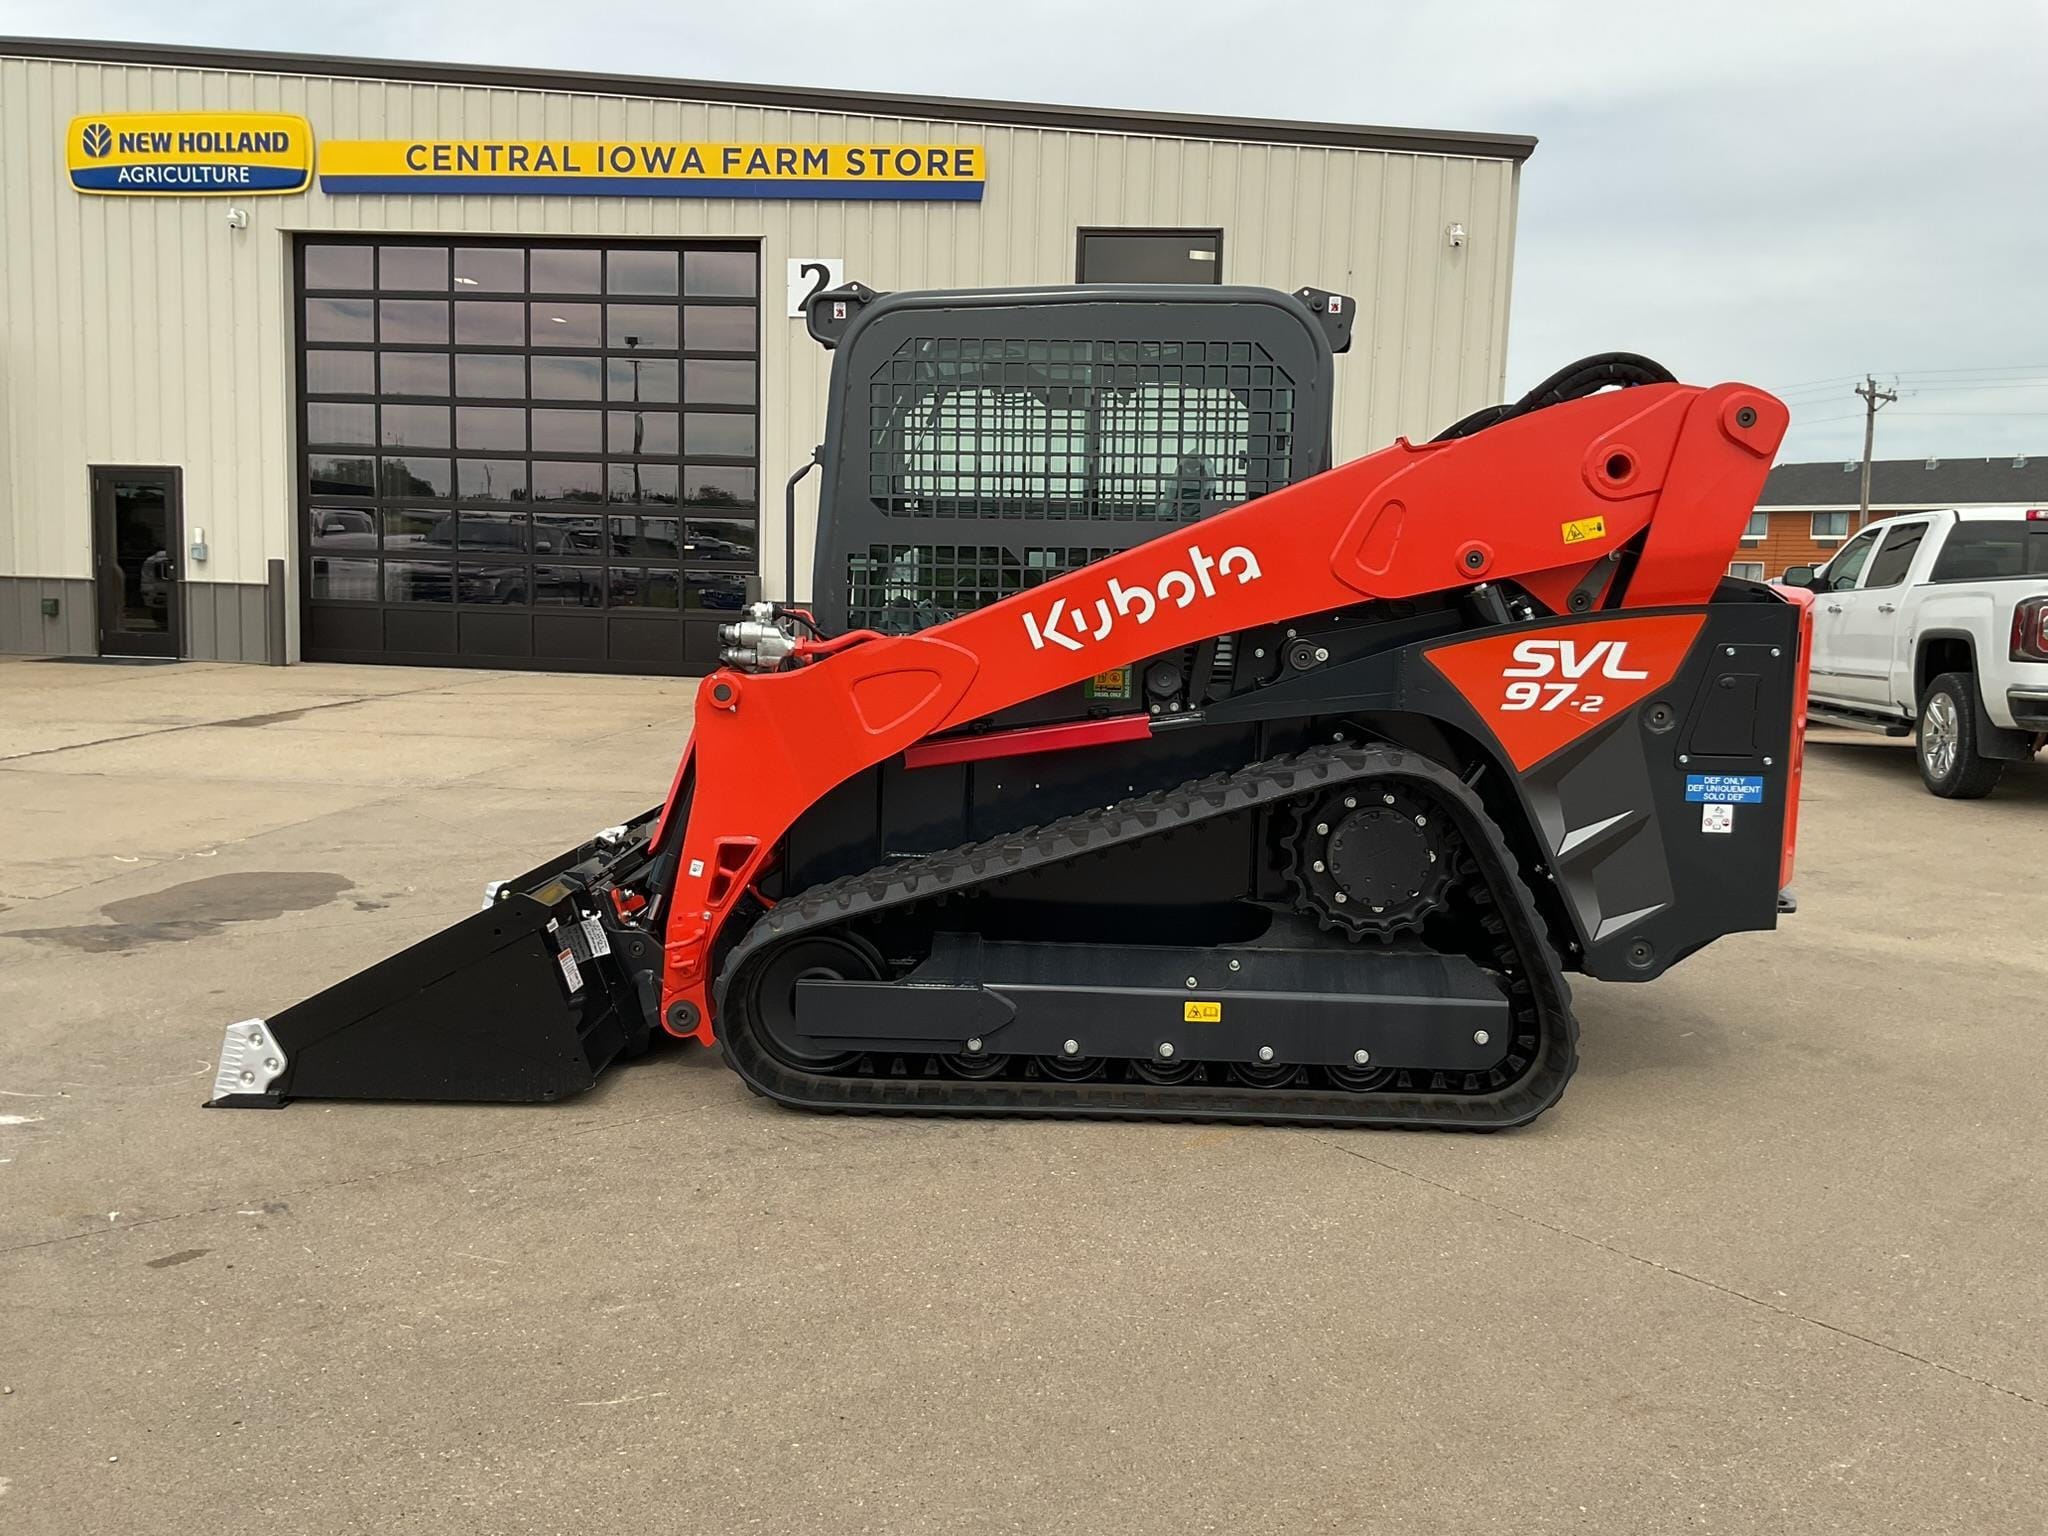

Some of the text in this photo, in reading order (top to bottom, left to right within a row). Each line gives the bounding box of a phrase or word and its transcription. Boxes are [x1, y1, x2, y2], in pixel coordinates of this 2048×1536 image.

[119, 131, 289, 153] NEW HOLLAND
[406, 144, 974, 176] CENTRAL IOWA FARM STORE
[118, 166, 250, 183] AGRICULTURE
[798, 263, 830, 311] 2
[1022, 545, 1262, 651] Kubota
[1502, 639, 1648, 680] SVL
[1500, 682, 1603, 712] 97-2
[1687, 784, 1760, 793] DEF UNIQUEMENT
[1703, 777, 1745, 785] DEF ONLY
[1703, 793, 1744, 801] SOLO DEF
